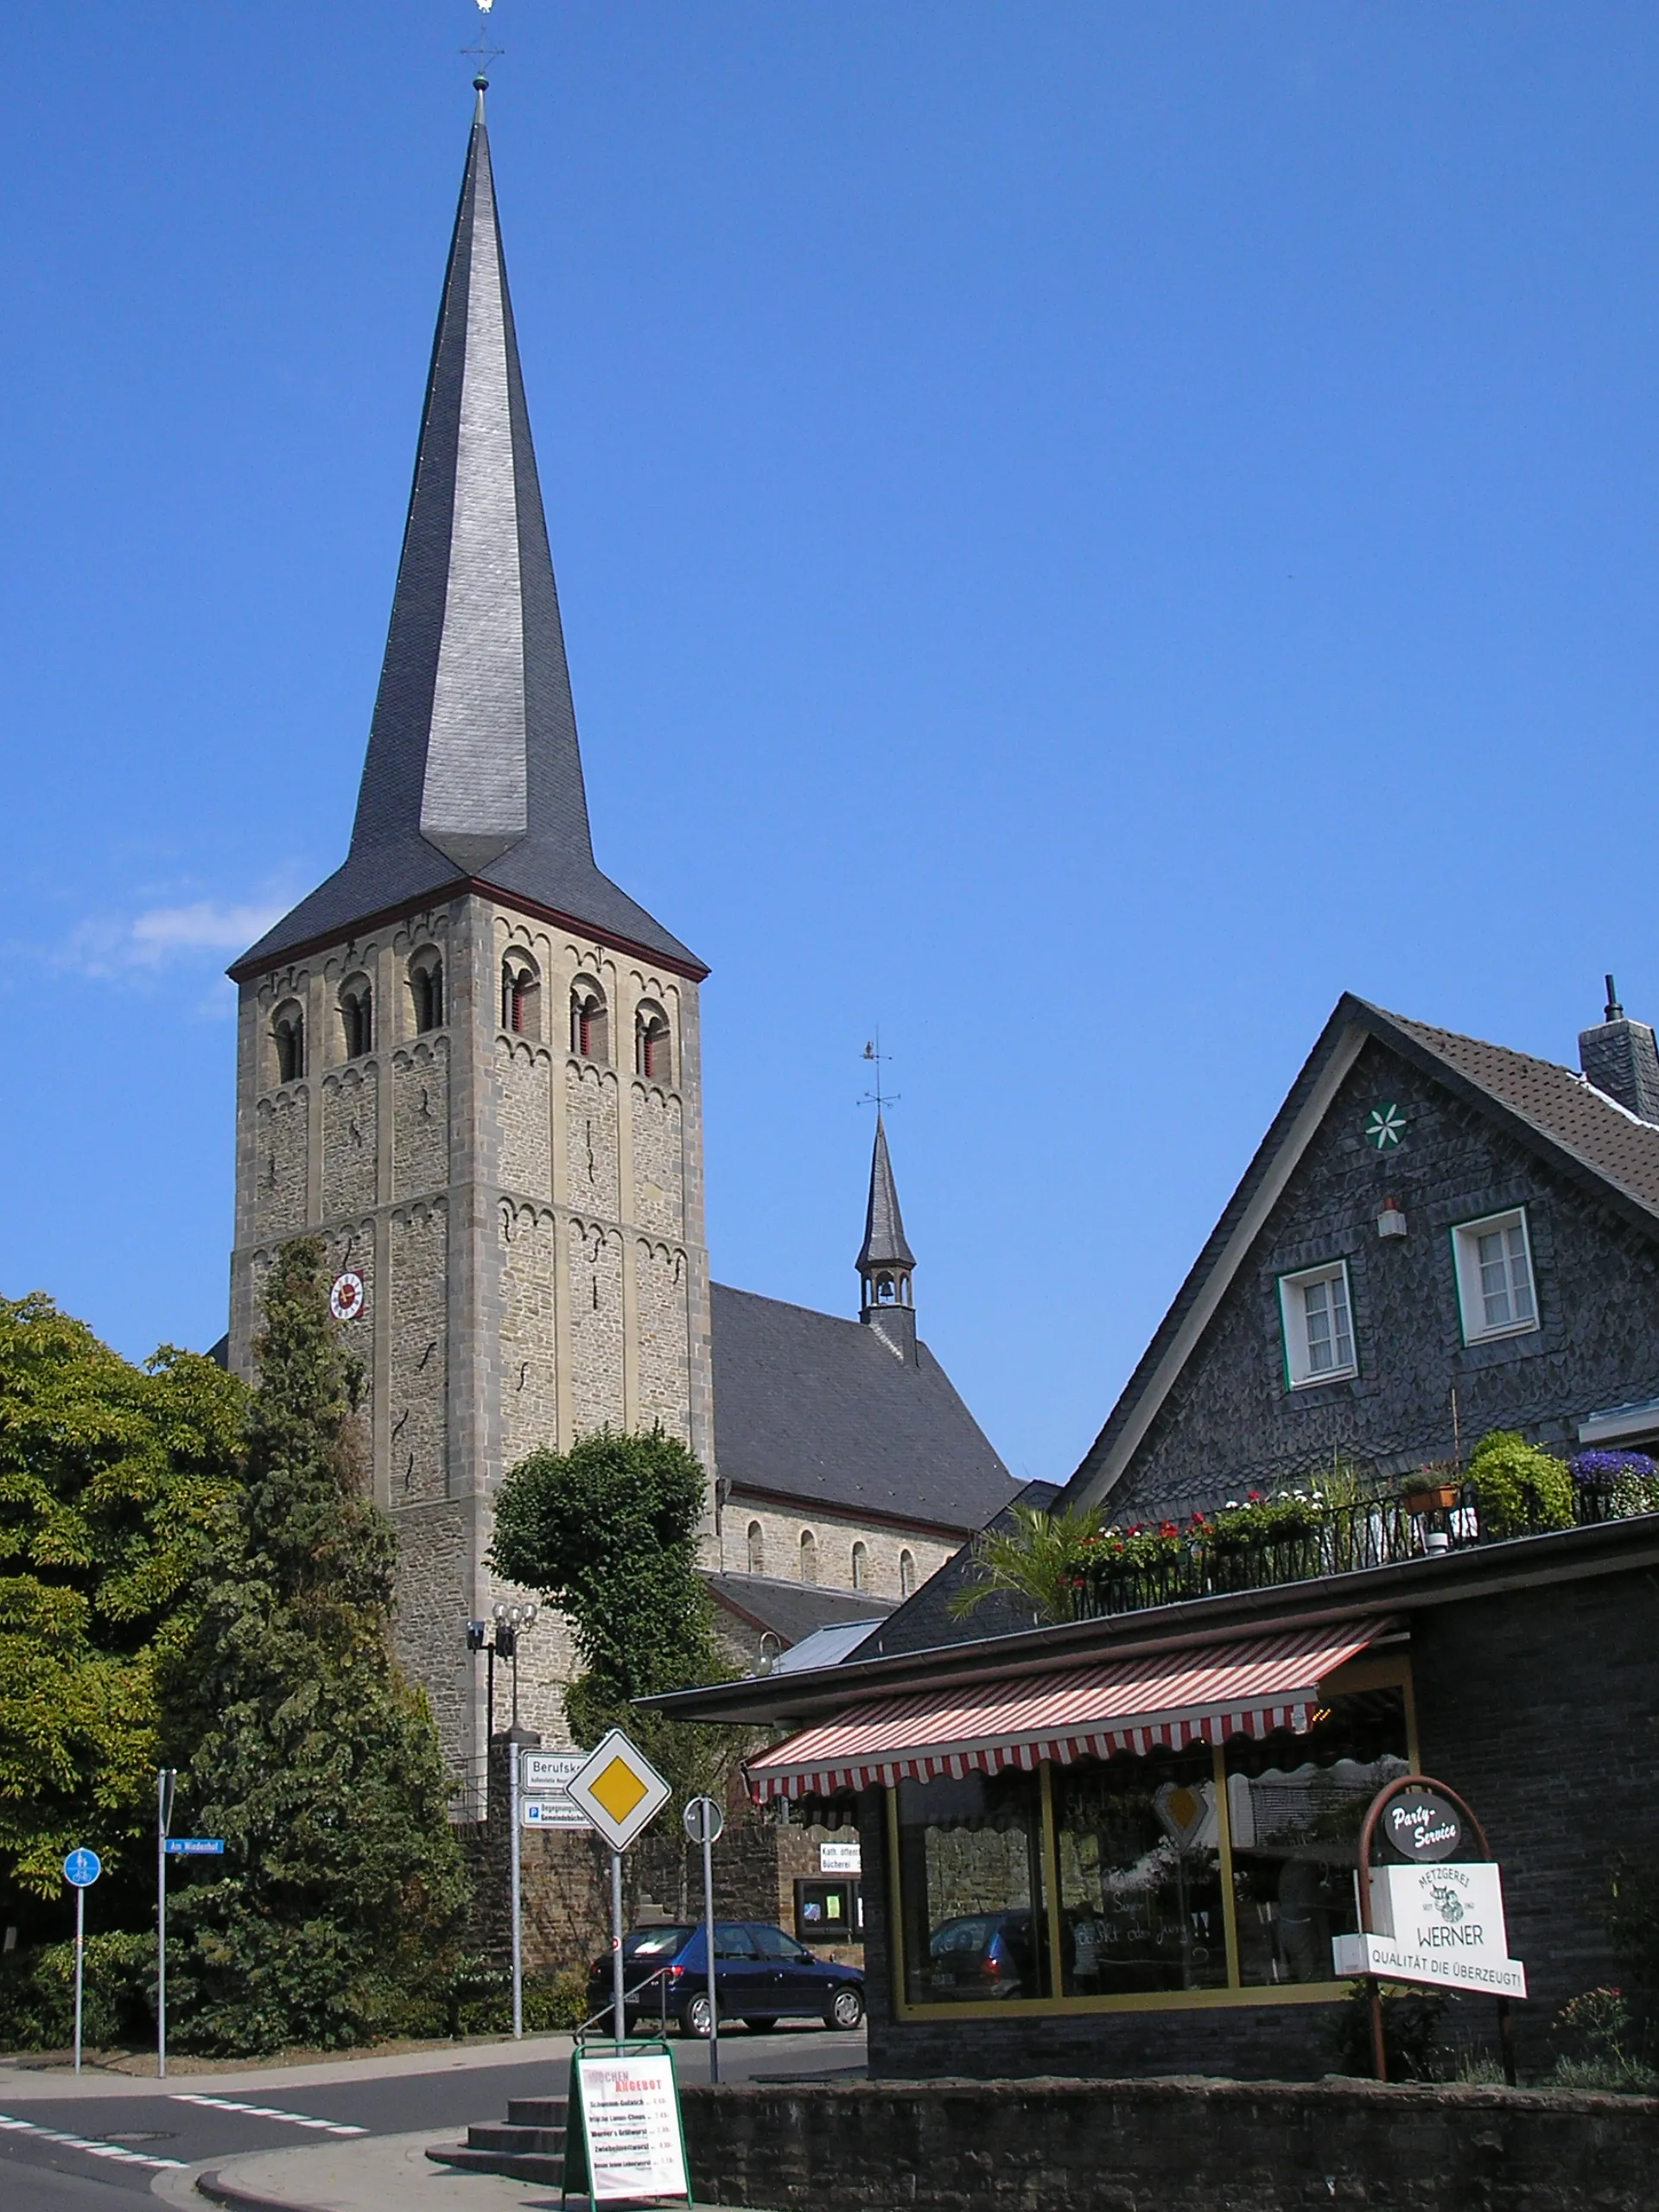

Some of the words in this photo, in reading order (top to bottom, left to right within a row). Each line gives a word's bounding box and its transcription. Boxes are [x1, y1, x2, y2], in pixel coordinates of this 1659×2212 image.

[1392, 1806, 1436, 1830] Party-
[170, 1841, 182, 1850] Am
[1414, 1822, 1456, 1848] Service
[823, 1859, 851, 1869] Bücherei
[1418, 1867, 1470, 1889] METZGEREI
[1417, 1924, 1484, 1948] WERNER
[1372, 1949, 1427, 1972] QUALITÄT
[1431, 1961, 1449, 1974] DIE
[1452, 1961, 1521, 1987] ÜBERZEUGT!
[589, 2071, 630, 2084] WOCHEN
[615, 2079, 663, 2093] ANGEBOT
